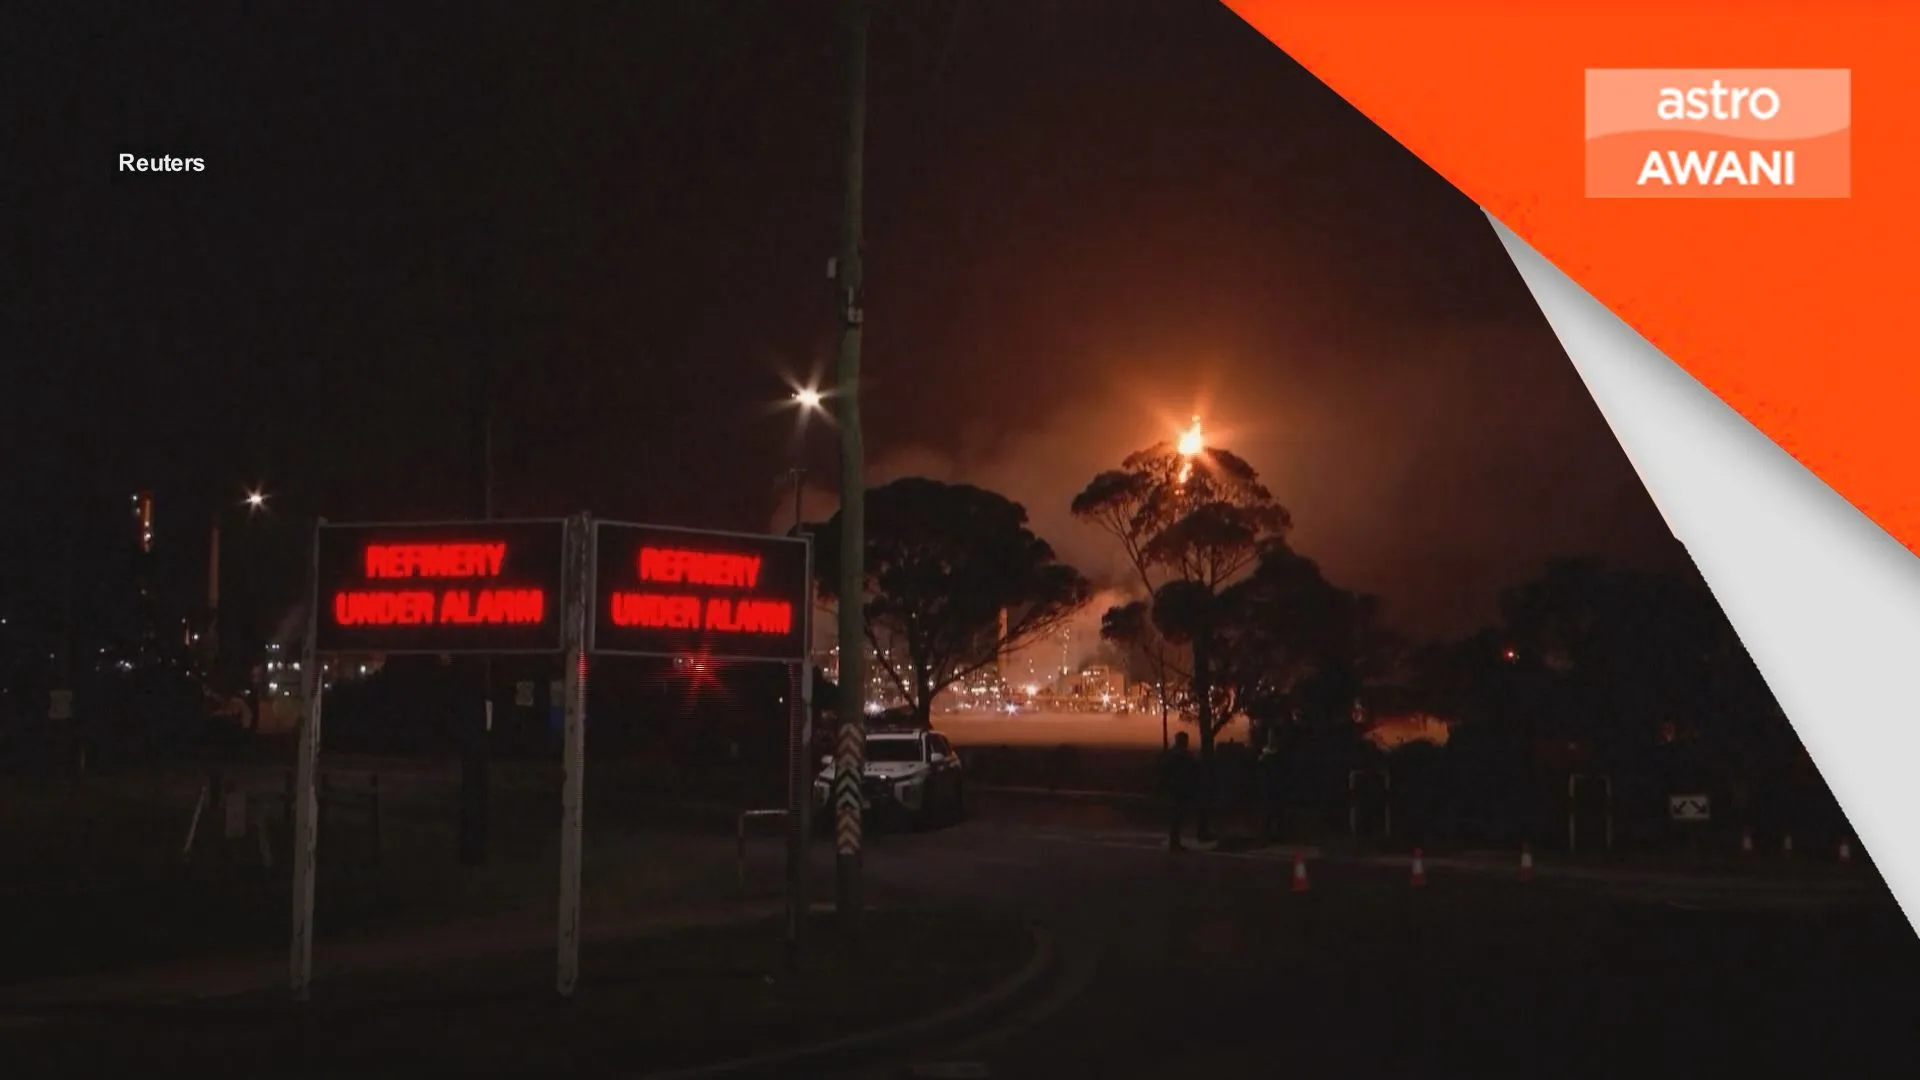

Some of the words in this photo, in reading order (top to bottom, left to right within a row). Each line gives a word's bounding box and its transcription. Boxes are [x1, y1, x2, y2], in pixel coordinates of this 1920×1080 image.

[366, 542, 506, 578] REFINERY
[639, 547, 760, 588] REFINERY
[335, 590, 434, 625] UNDER
[440, 588, 543, 624] ALARM
[611, 591, 700, 629] UNDER
[705, 596, 791, 634] ALARM
